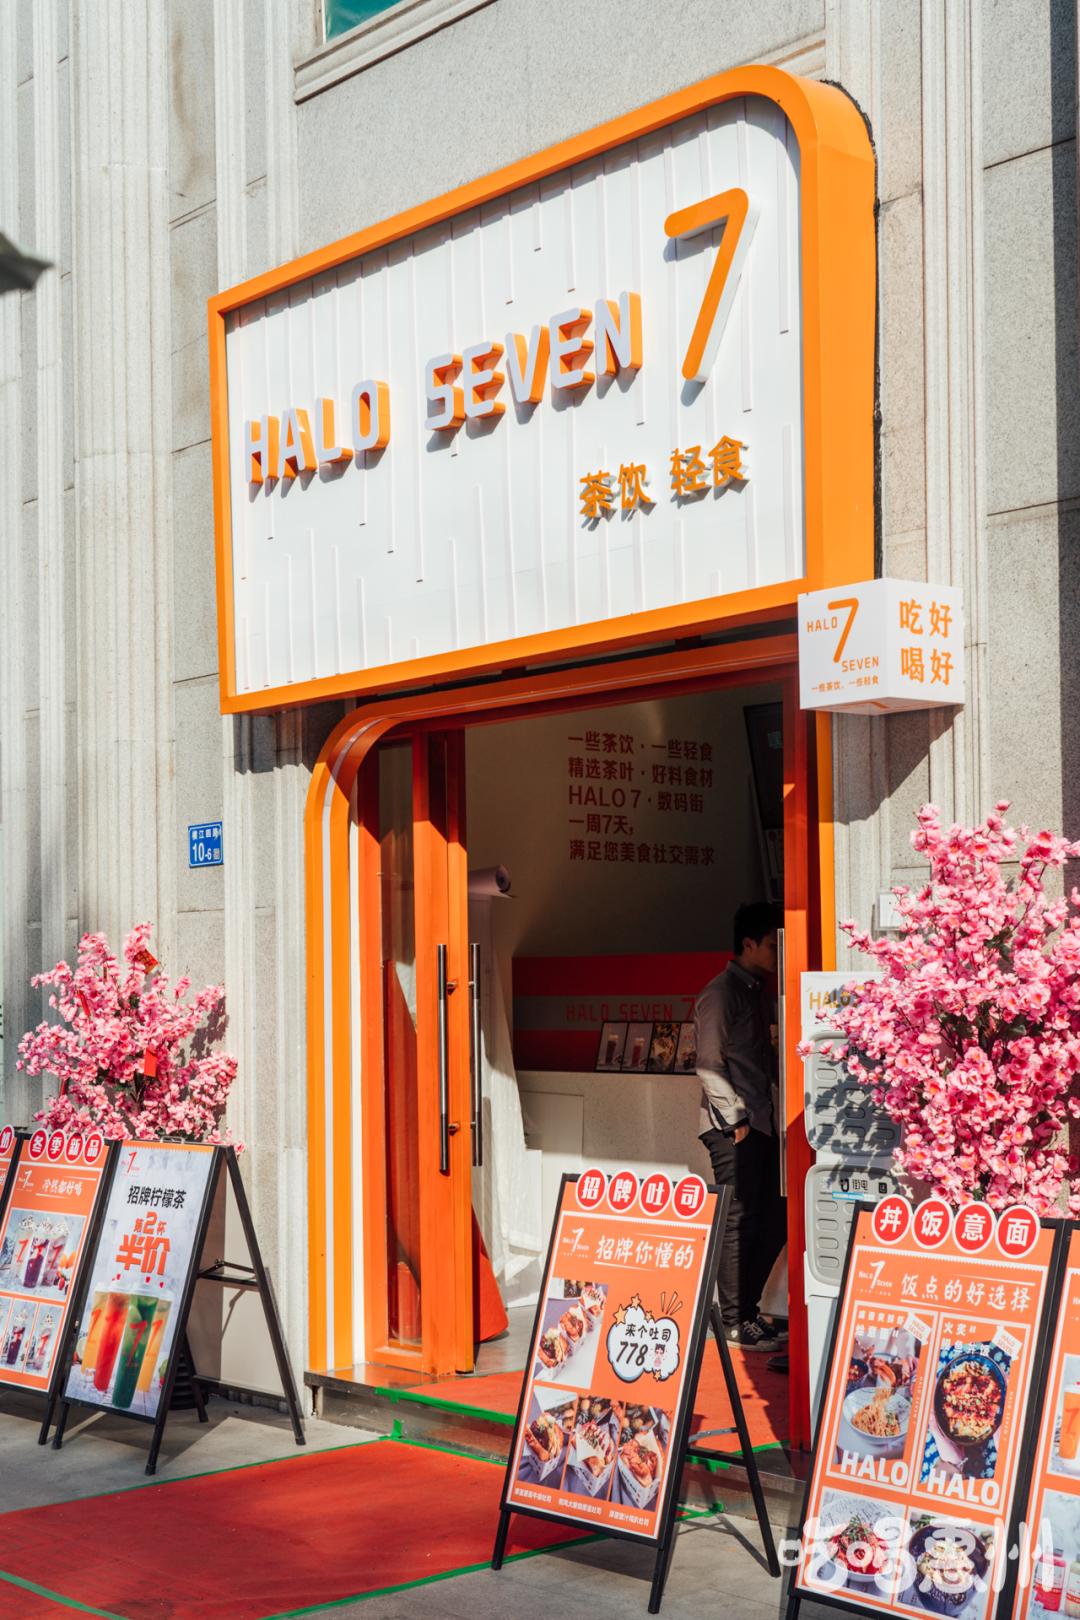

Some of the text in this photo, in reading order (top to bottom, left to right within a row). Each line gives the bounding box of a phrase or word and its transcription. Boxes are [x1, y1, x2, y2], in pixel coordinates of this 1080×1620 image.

[244, 187, 755, 485] HALO SEVEN 7
[580, 435, 745, 518] 茶饮 轻食
[807, 616, 837, 633] HALO
[828, 597, 859, 663] 7
[899, 598, 952, 638] 吃好
[842, 656, 879, 672] SEVEN
[901, 646, 954, 686] 喝好
[570, 839, 715, 867] 满足您美食社交需求
[565, 1004, 609, 1022] HALO
[619, 1003, 673, 1021] SEVEN
[32, 1134, 99, 1158] 冬季新品
[127, 1185, 186, 1209] 招牌柠檬茶
[581, 1176, 700, 1209] 招牌吐司
[134, 1211, 167, 1235] 第2杯
[879, 1205, 1032, 1247] 丼饭意面
[116, 1234, 171, 1276] 半价
[596, 1235, 694, 1269] 招牌你懂的
[901, 1273, 1031, 1313] 饭点的好选择
[625, 1323, 671, 1342] 来个吐司
[616, 1341, 648, 1366] 778
[840, 1450, 909, 1486] HALO
[927, 1468, 1000, 1506] HALO
